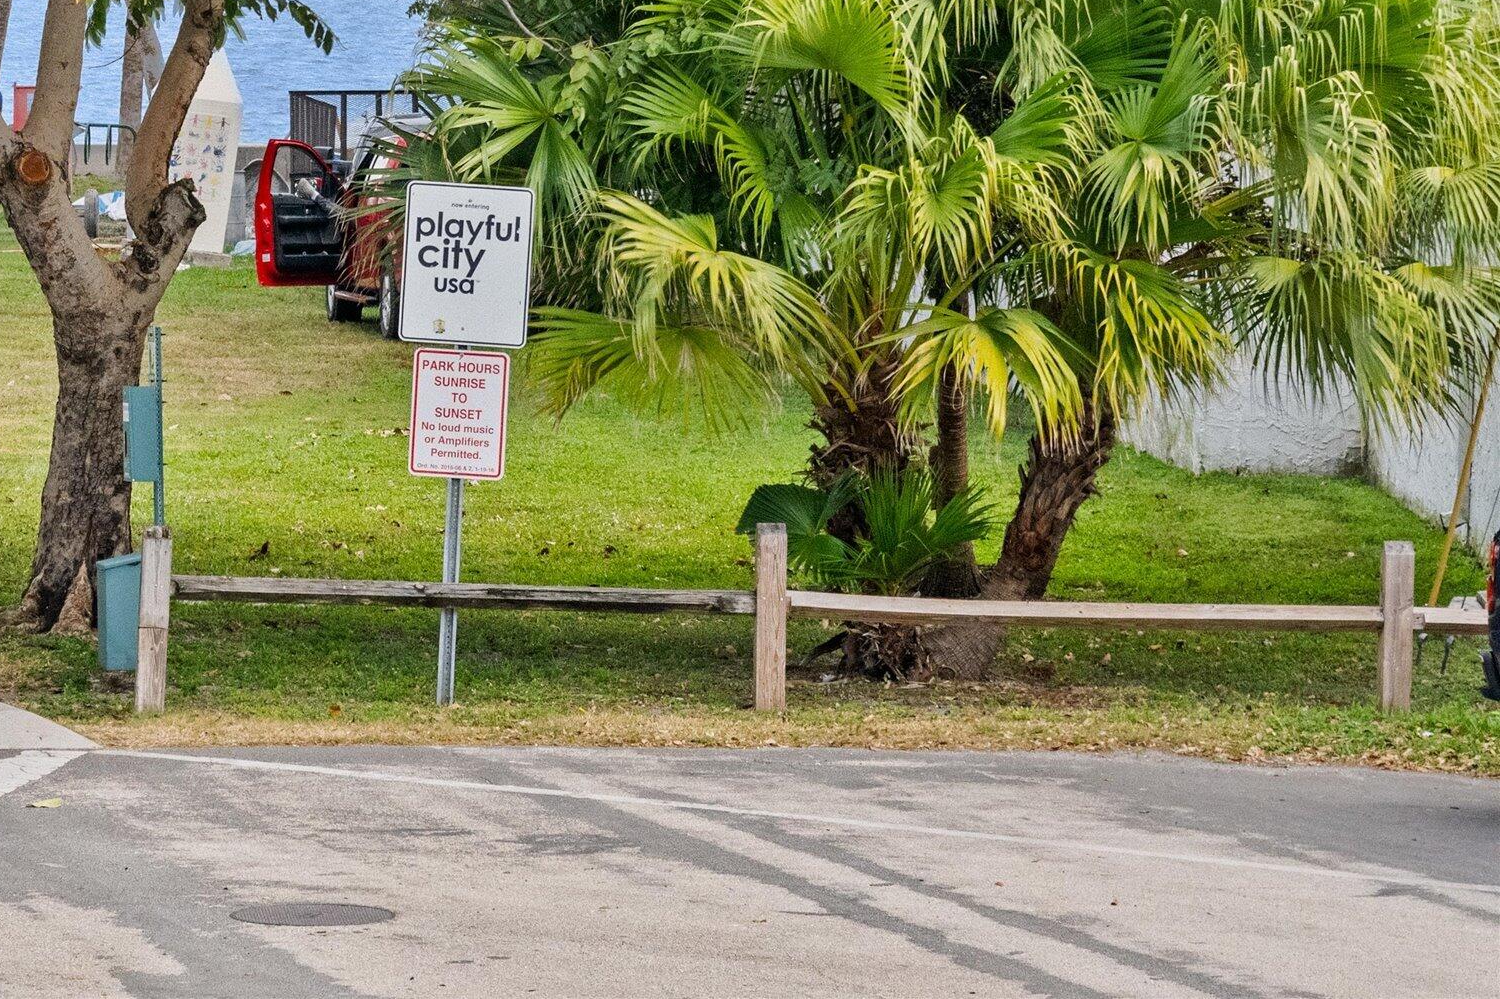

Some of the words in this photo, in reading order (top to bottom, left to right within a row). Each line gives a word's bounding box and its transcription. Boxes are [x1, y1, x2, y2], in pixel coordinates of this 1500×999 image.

[416, 212, 521, 245] playful
[418, 238, 486, 278] city
[434, 277, 475, 294] usa
[422, 360, 455, 372] PARK
[458, 362, 500, 374] HOURS
[434, 376, 486, 389] SUNRISE
[452, 393, 467, 403] TO
[435, 407, 482, 420] SUNSET
[422, 422, 435, 431] No
[438, 423, 460, 432] loud
[464, 425, 494, 434] music
[424, 436, 435, 444] or
[438, 436, 490, 448] Amplifiers
[431, 449, 482, 460] Permitted.
